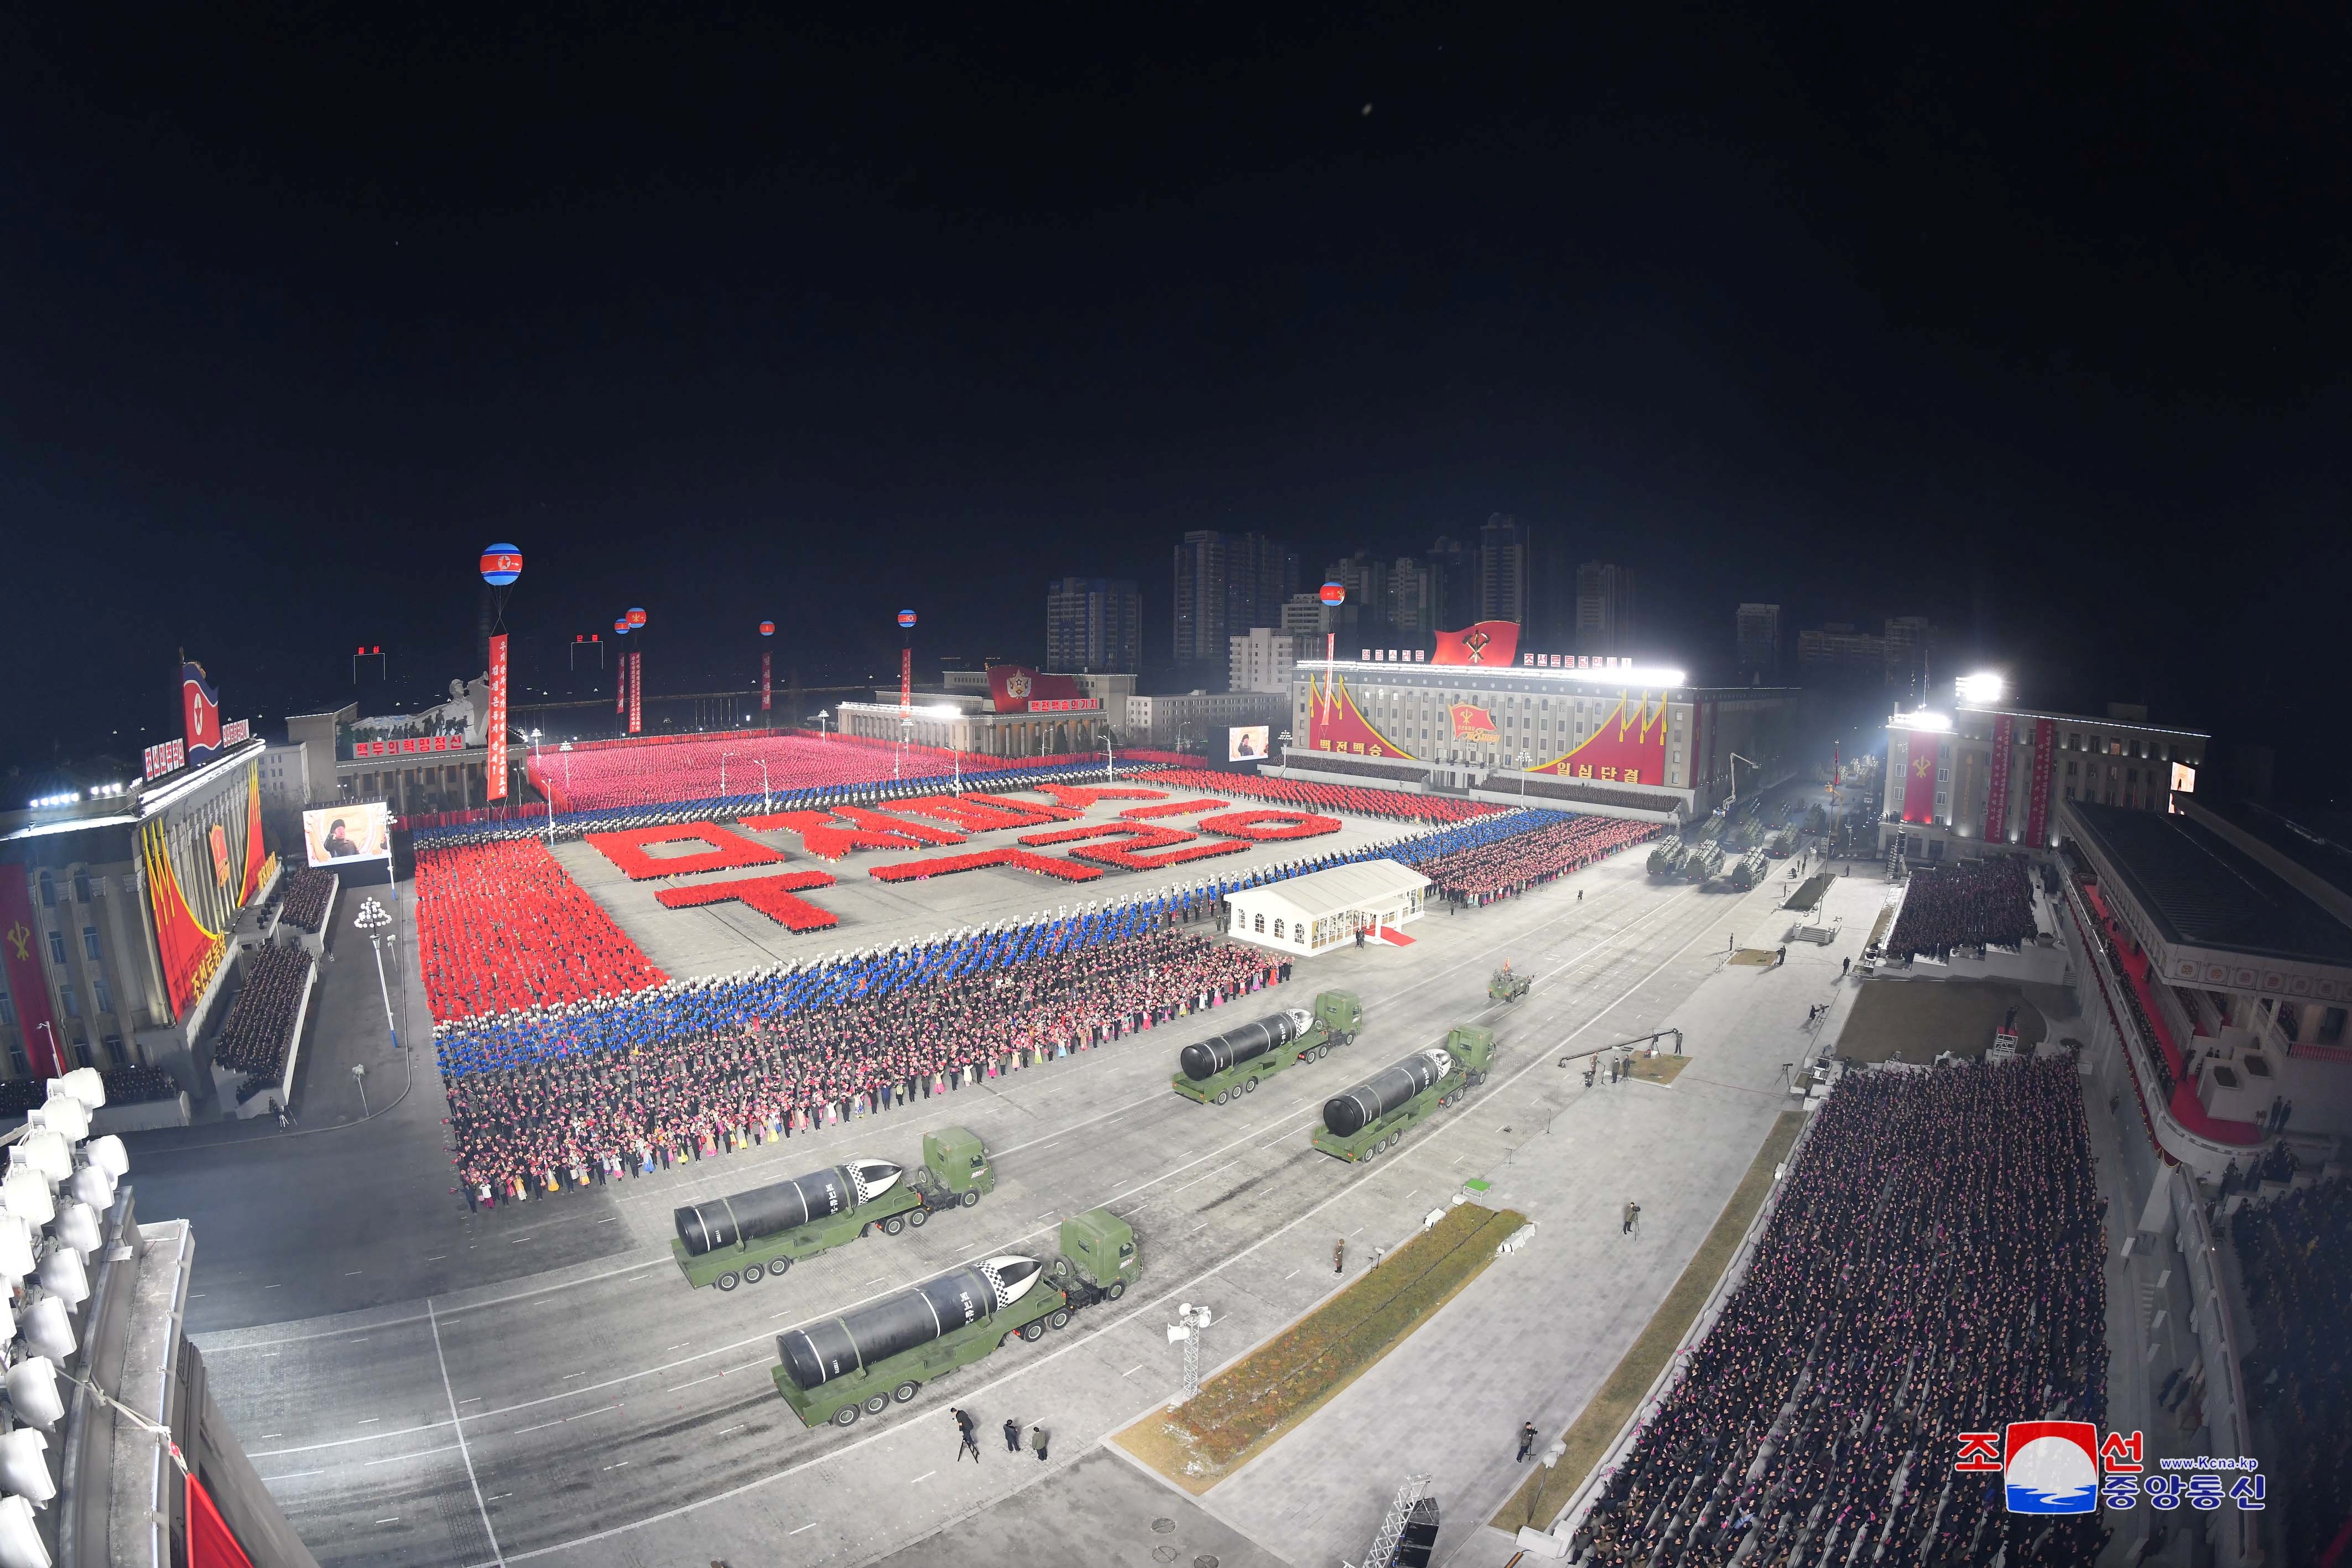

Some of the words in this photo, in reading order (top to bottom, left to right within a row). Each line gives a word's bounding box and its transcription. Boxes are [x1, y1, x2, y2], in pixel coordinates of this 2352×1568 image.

[1363, 650, 1423, 661] 영광스러운
[1320, 739, 1382, 757] 백전백승
[1557, 762, 1639, 784] 일심단결
[191, 929, 226, 1007] 조선로동당
